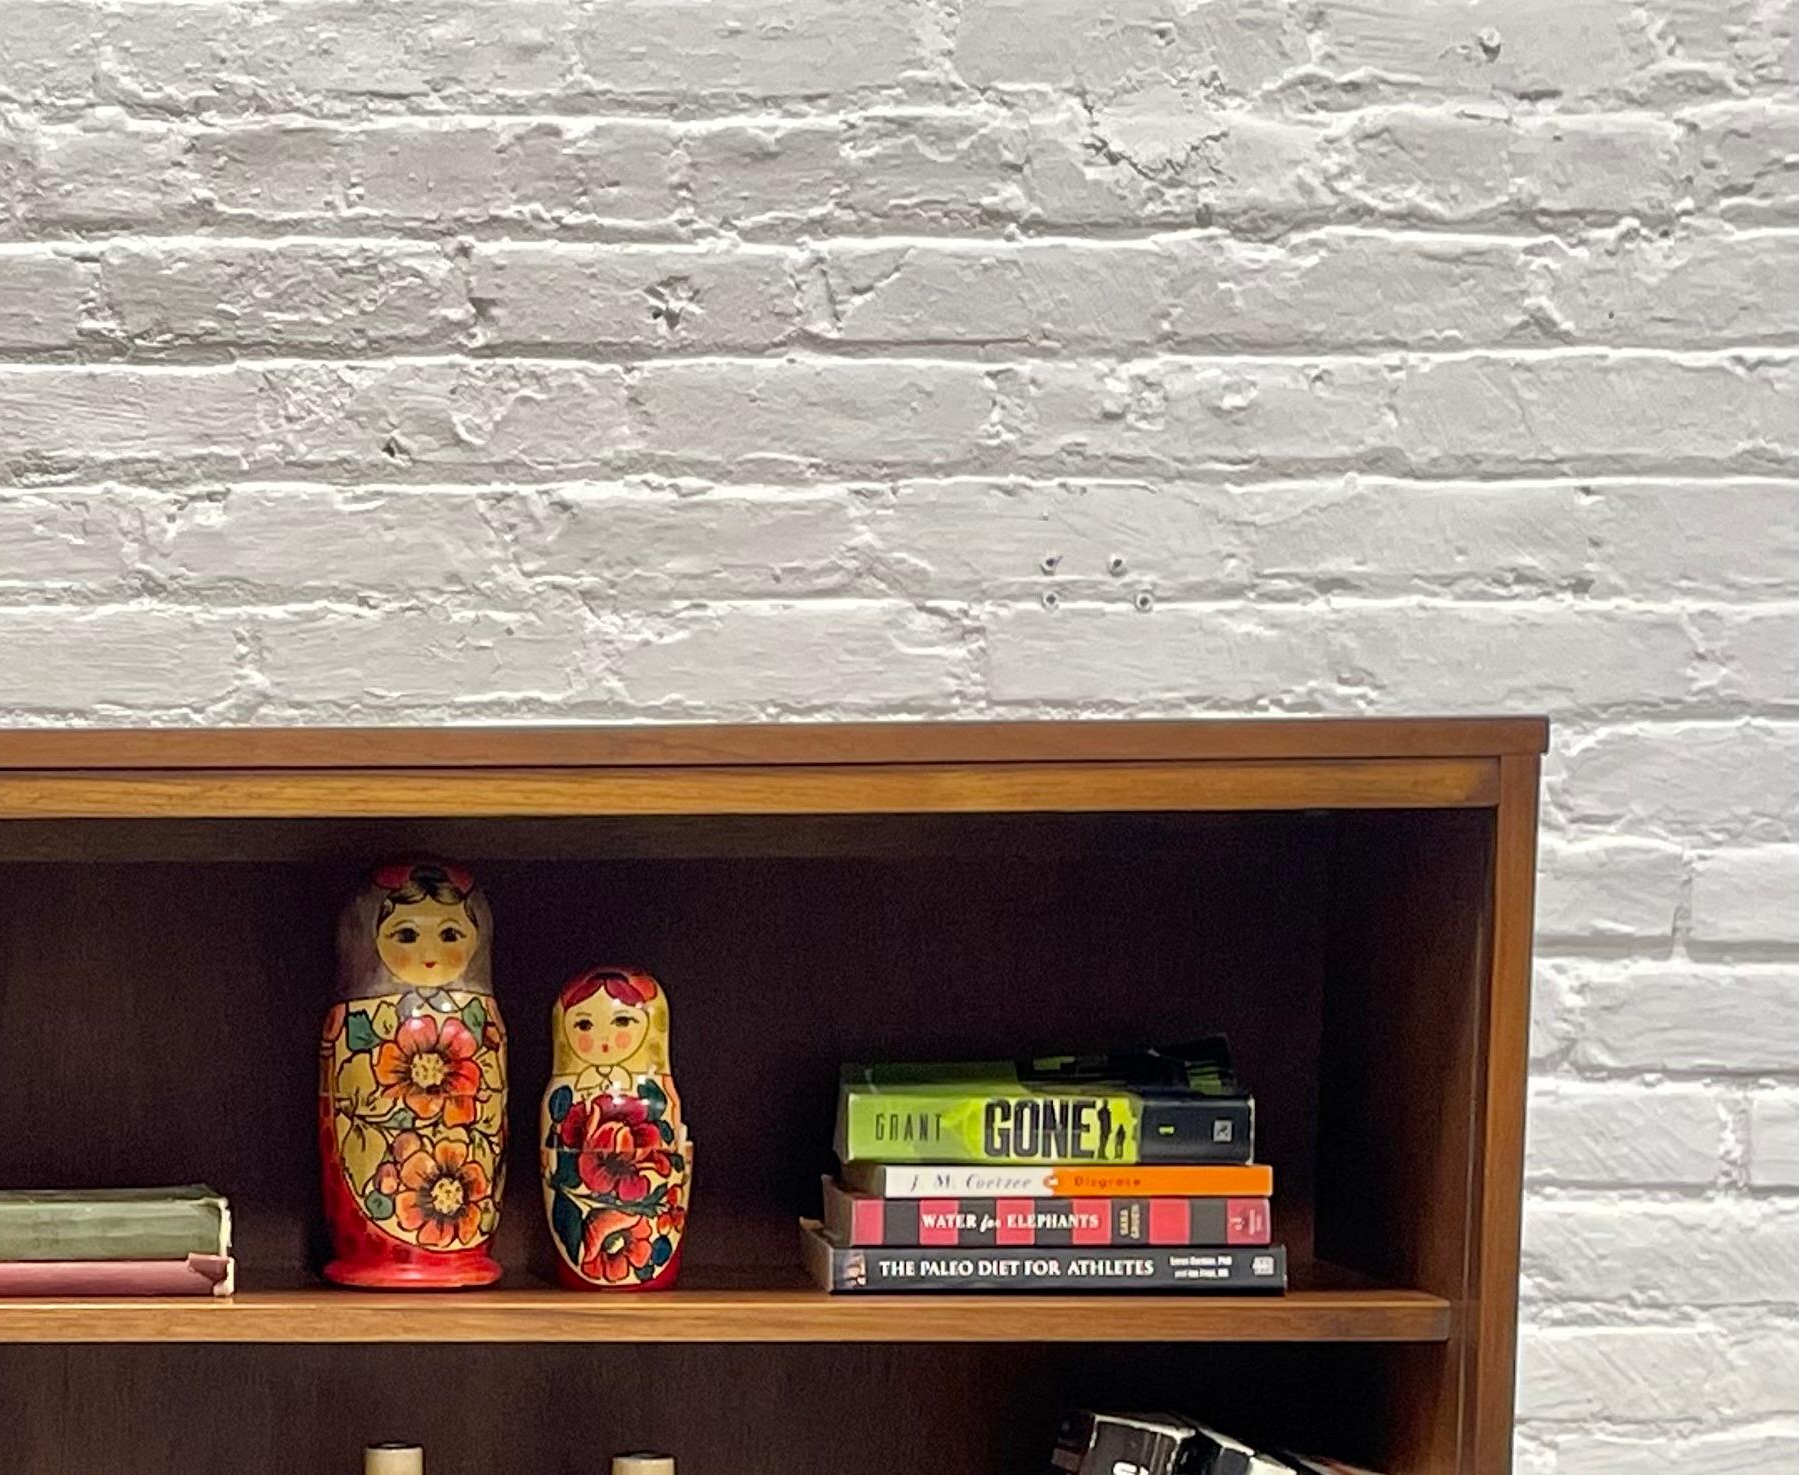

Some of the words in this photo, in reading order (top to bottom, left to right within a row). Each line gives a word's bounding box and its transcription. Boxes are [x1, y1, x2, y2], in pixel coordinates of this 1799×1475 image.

[875, 1112, 942, 1141] GRANT
[984, 1099, 1097, 1159] GONE
[965, 1173, 1032, 1189] Coetzee
[1074, 1174, 1142, 1189] Disgrace
[922, 1213, 976, 1229] WATER
[980, 1213, 1000, 1232] for
[1007, 1212, 1099, 1229] ELEPHANTS
[879, 1260, 916, 1276] THE
[920, 1260, 974, 1276] PALEO
[978, 1260, 1020, 1276] DIET
[1024, 1260, 1061, 1276] FOR
[1067, 1259, 1154, 1276] ATHLETES
